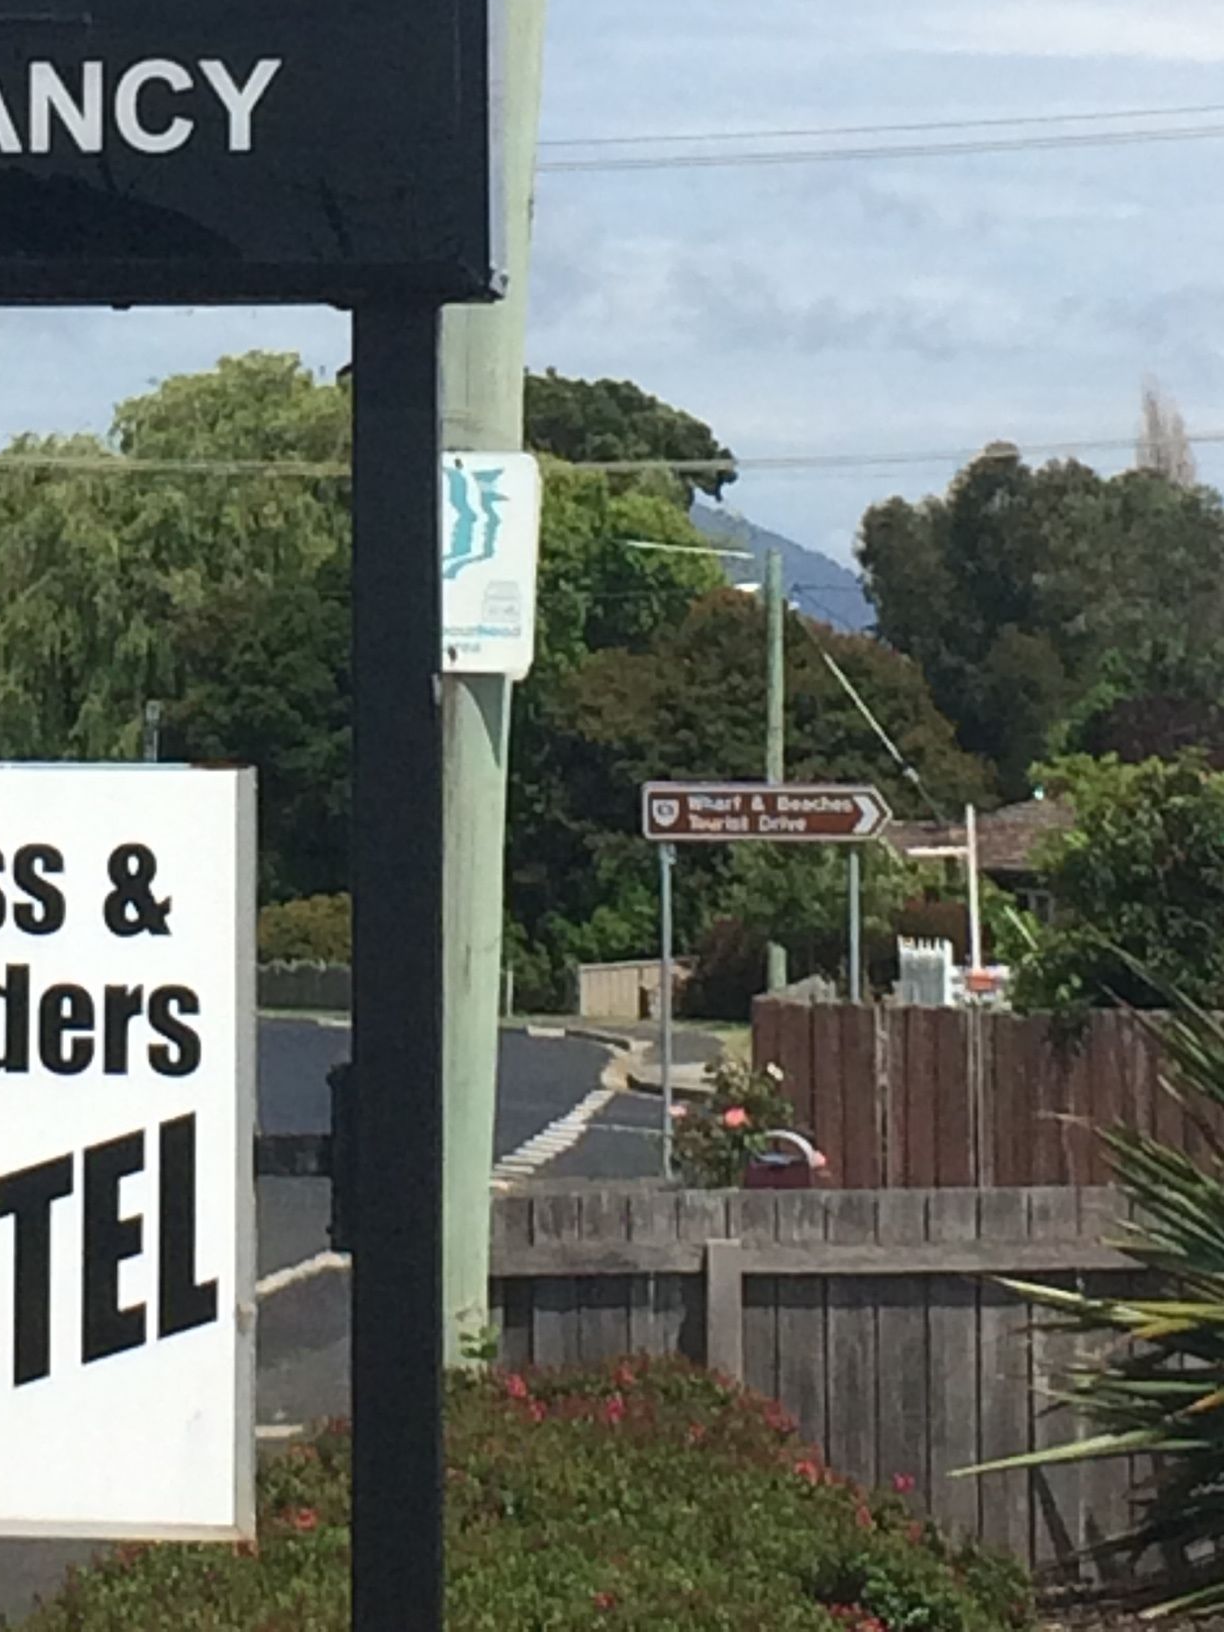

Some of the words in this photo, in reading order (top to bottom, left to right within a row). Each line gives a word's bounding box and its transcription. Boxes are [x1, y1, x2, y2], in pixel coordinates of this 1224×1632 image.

[688, 795, 742, 811] Wharf
[752, 795, 765, 811] &
[778, 796, 853, 812] Beaches
[689, 816, 748, 831] Tourist
[759, 817, 806, 832] Drive
[104, 844, 170, 937] &
